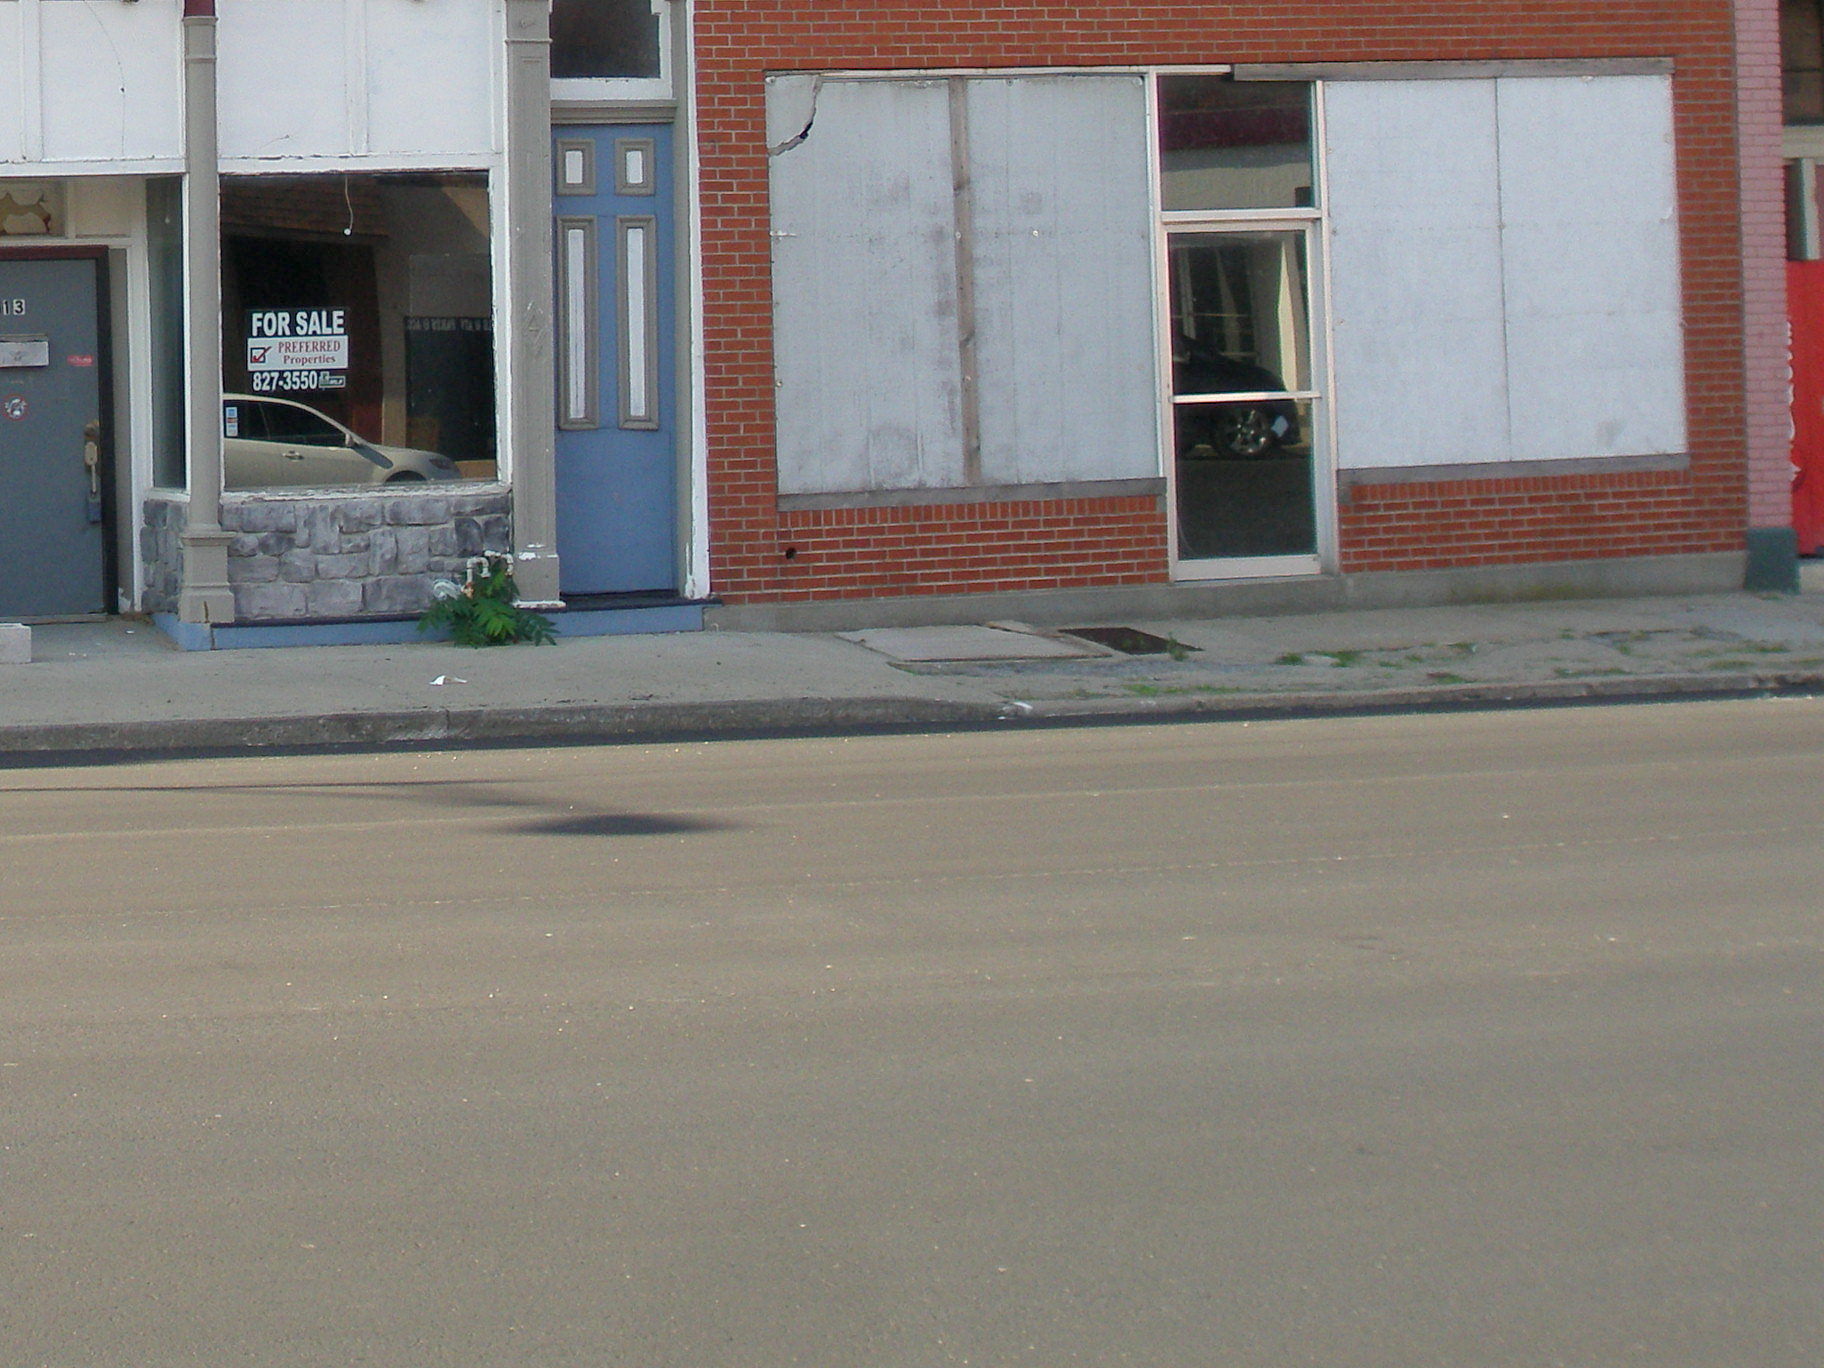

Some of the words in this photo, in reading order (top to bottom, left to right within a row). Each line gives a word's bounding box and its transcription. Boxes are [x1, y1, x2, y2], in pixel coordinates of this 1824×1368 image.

[252, 312, 291, 336] FOR
[295, 310, 345, 335] SALE
[278, 340, 341, 354] PREFERRED
[283, 354, 336, 366] Properties
[253, 370, 318, 391] 827-3550
